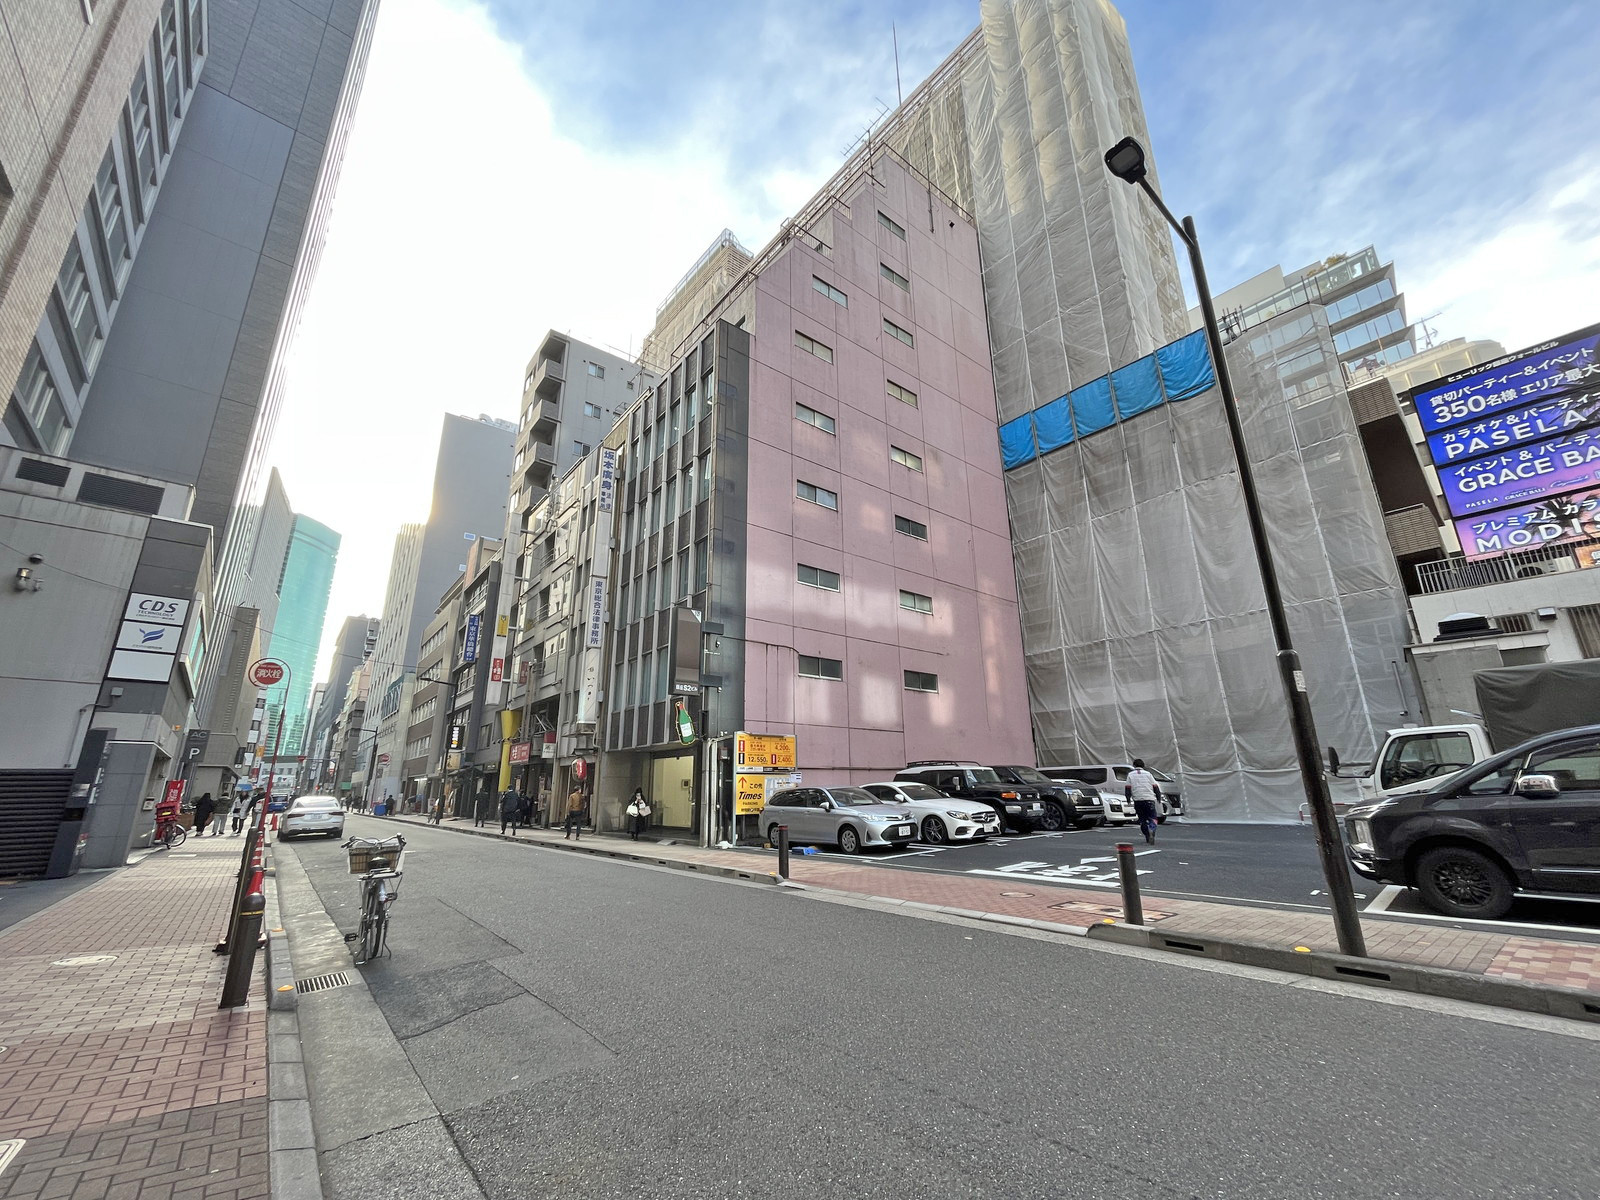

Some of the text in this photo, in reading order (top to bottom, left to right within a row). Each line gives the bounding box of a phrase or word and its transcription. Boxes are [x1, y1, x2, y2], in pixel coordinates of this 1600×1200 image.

[1435, 363, 1600, 424] 350名様 エリア最大
[1445, 410, 1587, 459] PASELA
[1459, 457, 1555, 493] GRACE
[1466, 497, 1498, 509] PASELA
[1472, 508, 1557, 535] プレミアム
[139, 599, 179, 613] CDS
[256, 669, 281, 679] 消火栓
[189, 748, 200, 760] P
[739, 791, 762, 800] Times
